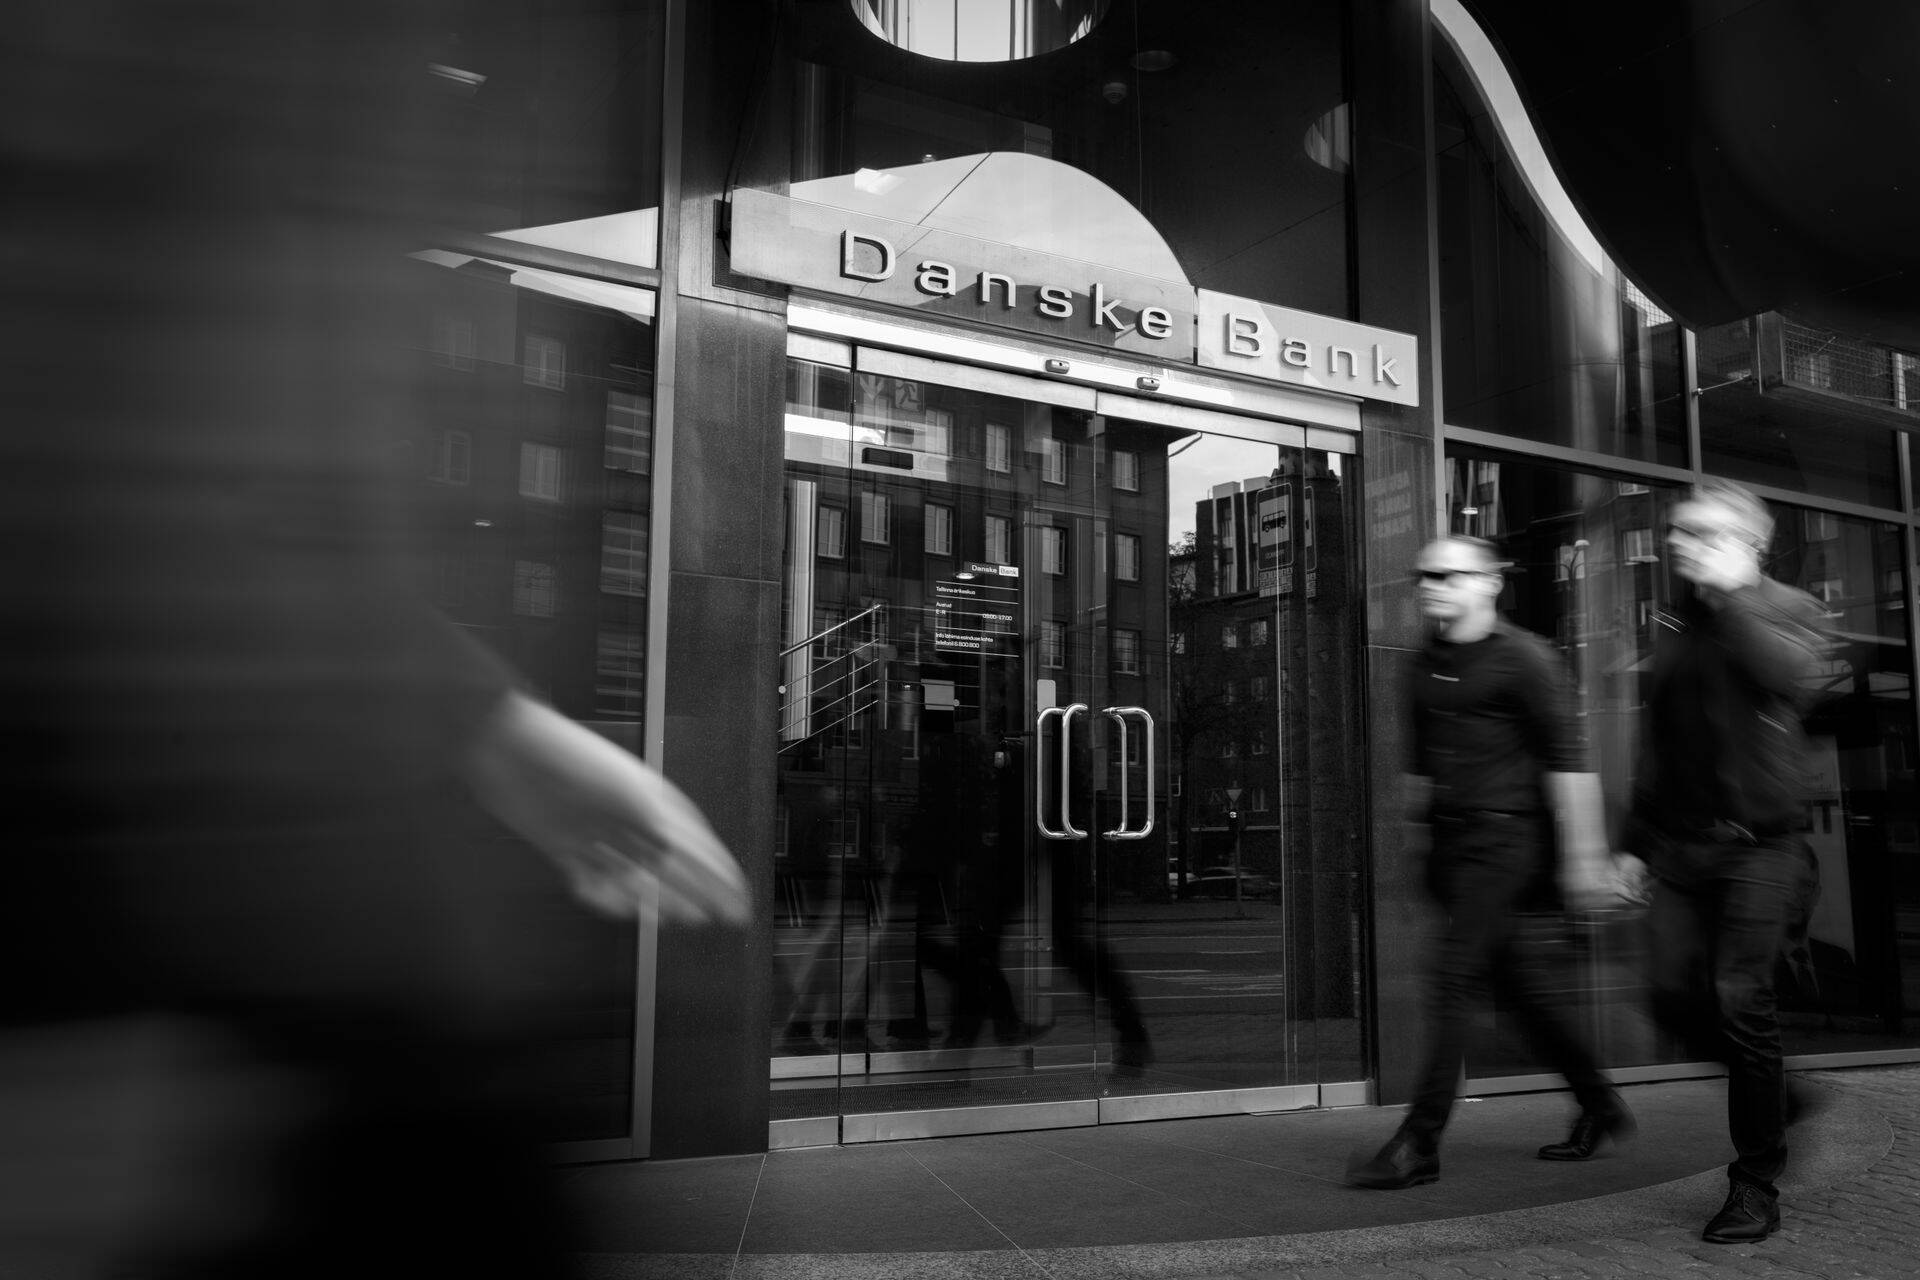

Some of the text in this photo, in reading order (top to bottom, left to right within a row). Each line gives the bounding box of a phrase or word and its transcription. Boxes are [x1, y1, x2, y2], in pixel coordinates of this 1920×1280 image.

[839, 229, 1401, 386] Danske Bank
[971, 564, 1017, 576] Danske Bank
